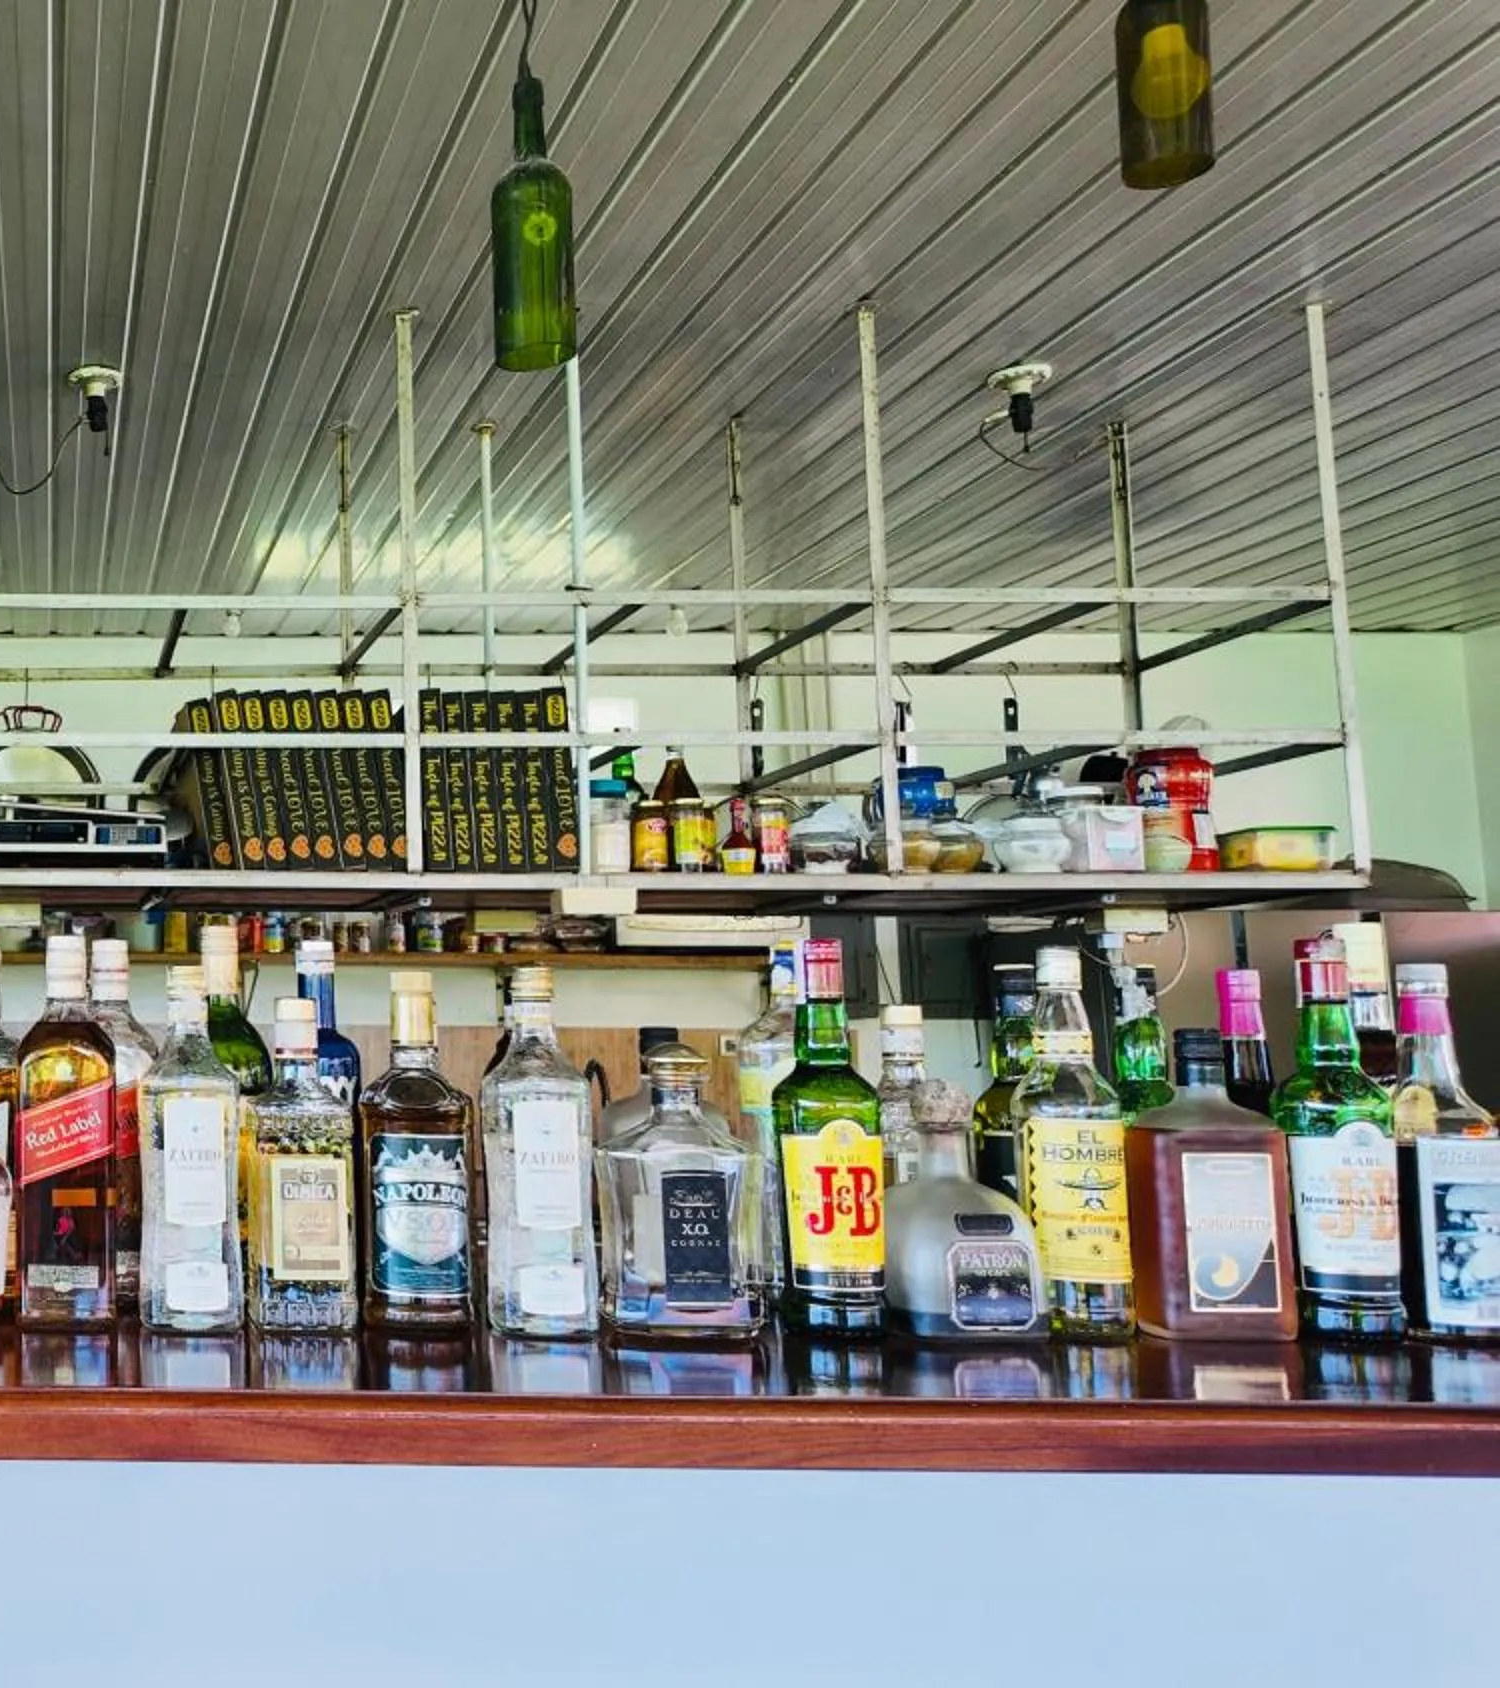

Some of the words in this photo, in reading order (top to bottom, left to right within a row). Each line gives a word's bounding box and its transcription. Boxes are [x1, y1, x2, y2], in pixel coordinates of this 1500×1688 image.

[25, 1125, 58, 1150] Red
[59, 1109, 103, 1137] Label
[1077, 1129, 1103, 1145] EL
[1043, 1146, 1124, 1162] HOMBRE
[805, 1165, 882, 1237] J&B
